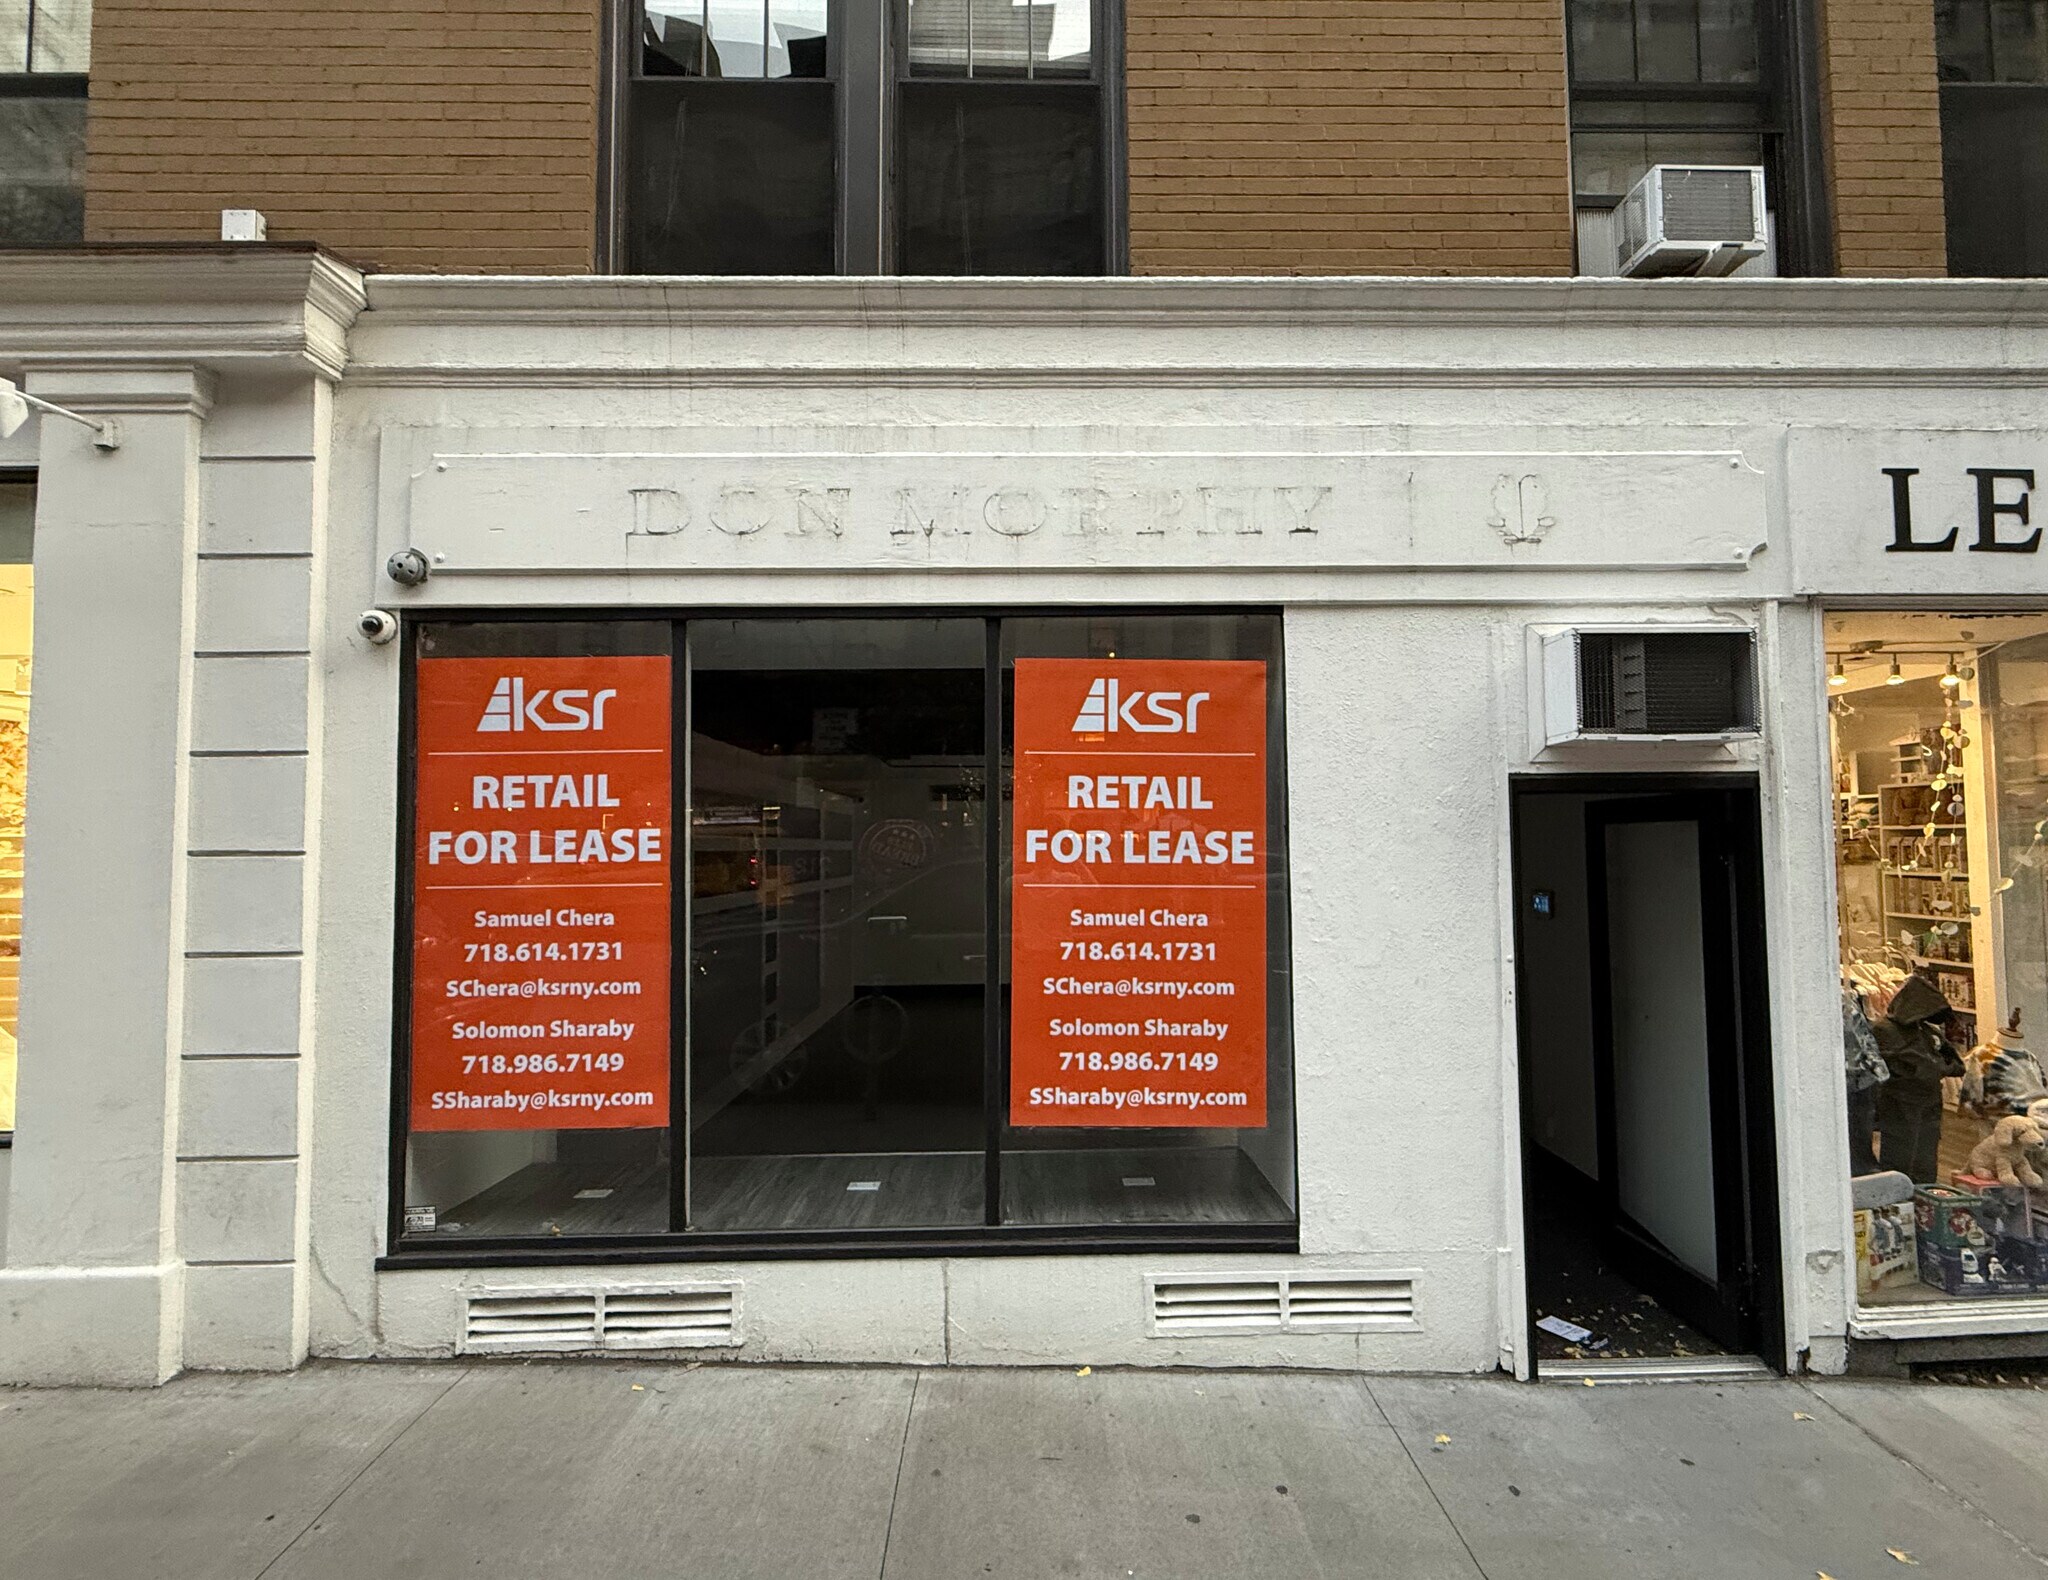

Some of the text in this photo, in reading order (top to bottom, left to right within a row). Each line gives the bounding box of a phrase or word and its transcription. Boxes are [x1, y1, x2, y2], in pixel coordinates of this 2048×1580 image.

[1881, 467, 2043, 553] LE
[473, 774, 620, 811] RETAIL
[1068, 775, 1214, 810] RETAIL
[428, 828, 662, 865] FOR LEASE
[1026, 830, 1255, 865] FOR LEASE
[474, 908, 615, 928] Samuel Chera
[1070, 908, 1209, 927] Samuel Chera
[464, 941, 623, 962] 718.614.1731
[1060, 941, 1216, 961] 718.614.1731
[446, 978, 641, 1000] SChera@ksrny.com
[1043, 976, 1235, 999] SChera@ksrny.com
[452, 1018, 635, 1041] Solomon Sharaby
[1049, 1018, 1229, 1041] Solomon Sharaby
[462, 1052, 625, 1074] 718.986.7149
[1059, 1051, 1219, 1072] 718.986.7149
[431, 1089, 654, 1113] SSharaby@ksrny.com
[1029, 1086, 1247, 1110] SSharaby@ksrny.com
